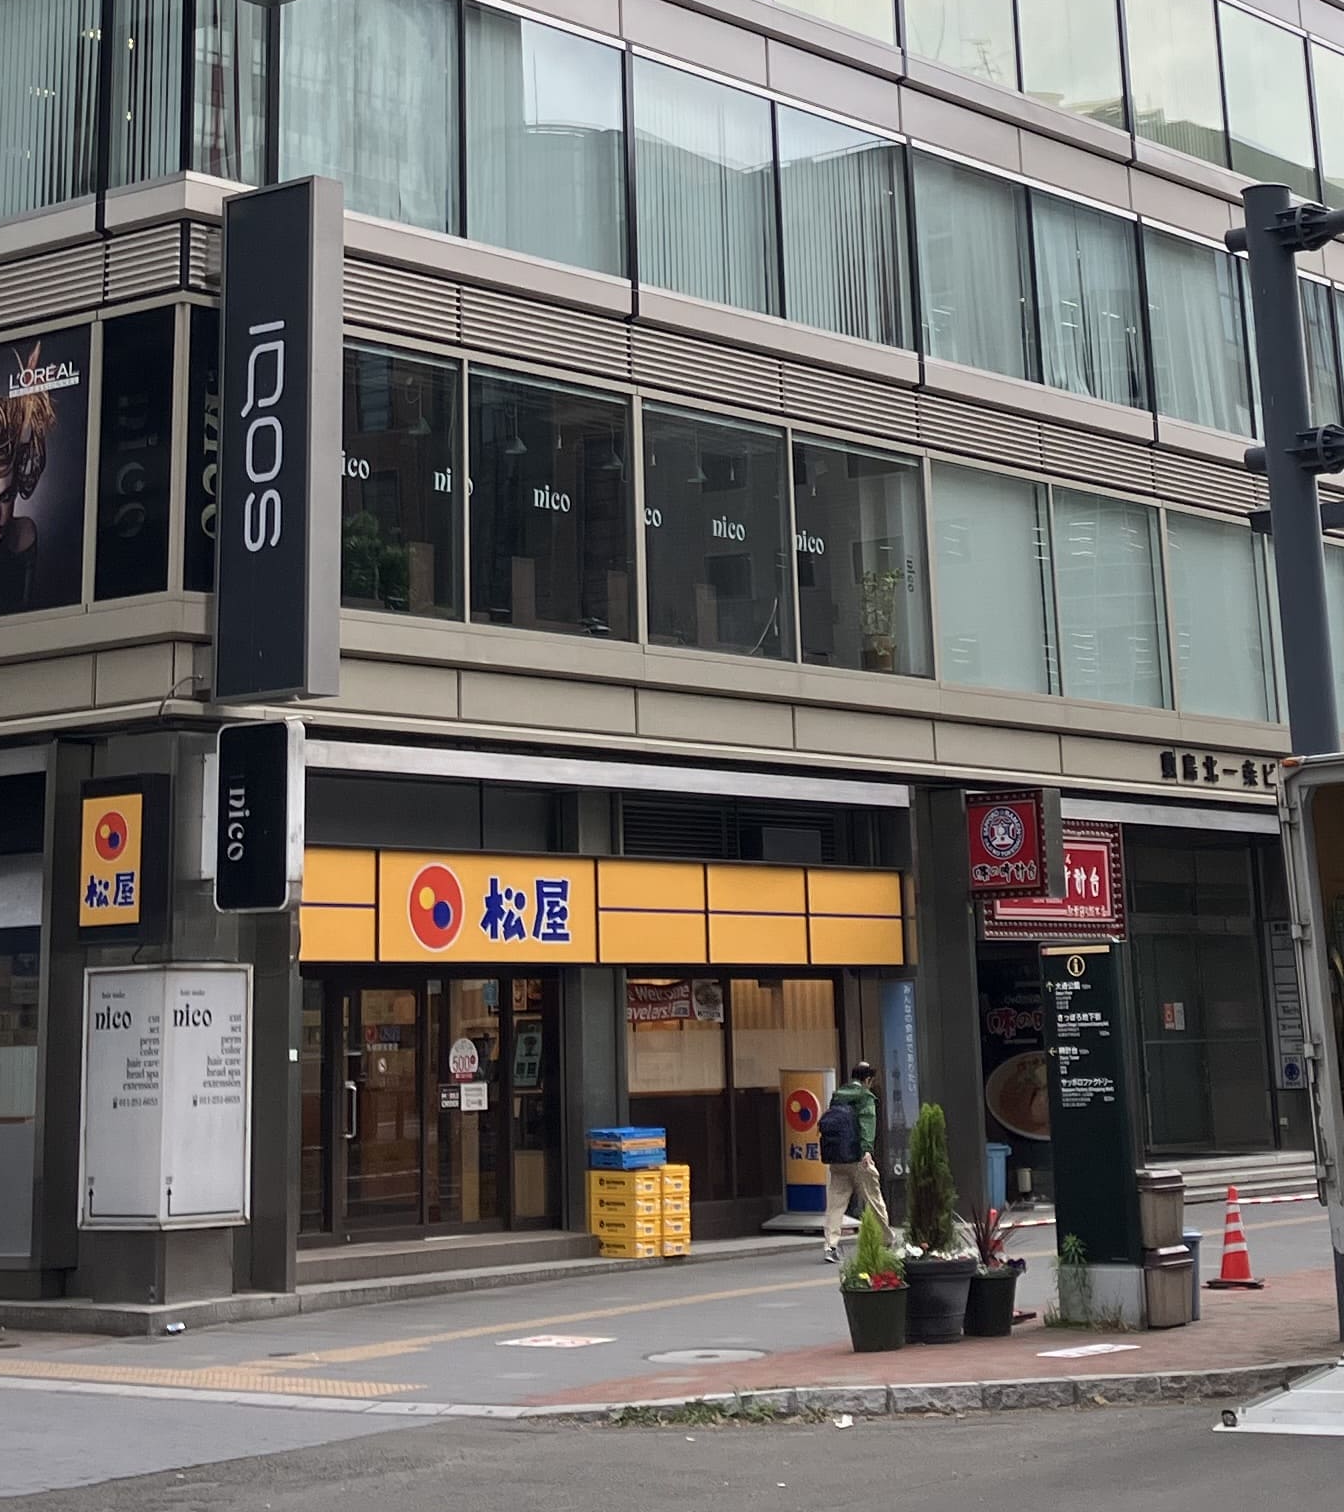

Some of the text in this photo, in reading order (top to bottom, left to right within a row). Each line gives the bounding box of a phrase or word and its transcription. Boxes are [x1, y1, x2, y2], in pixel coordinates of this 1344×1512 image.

[241, 319, 286, 553] IQOS
[341, 451, 370, 479] ico
[533, 485, 571, 513] nico
[712, 515, 746, 542] nico
[1159, 751, 1277, 787] 敷島北一条ビ
[227, 787, 251, 861] nico
[84, 871, 136, 908] 松屋
[480, 875, 571, 943] 松屋
[95, 1006, 132, 1030] nico
[173, 1003, 213, 1028] nico
[627, 1003, 672, 1020] avelers!
